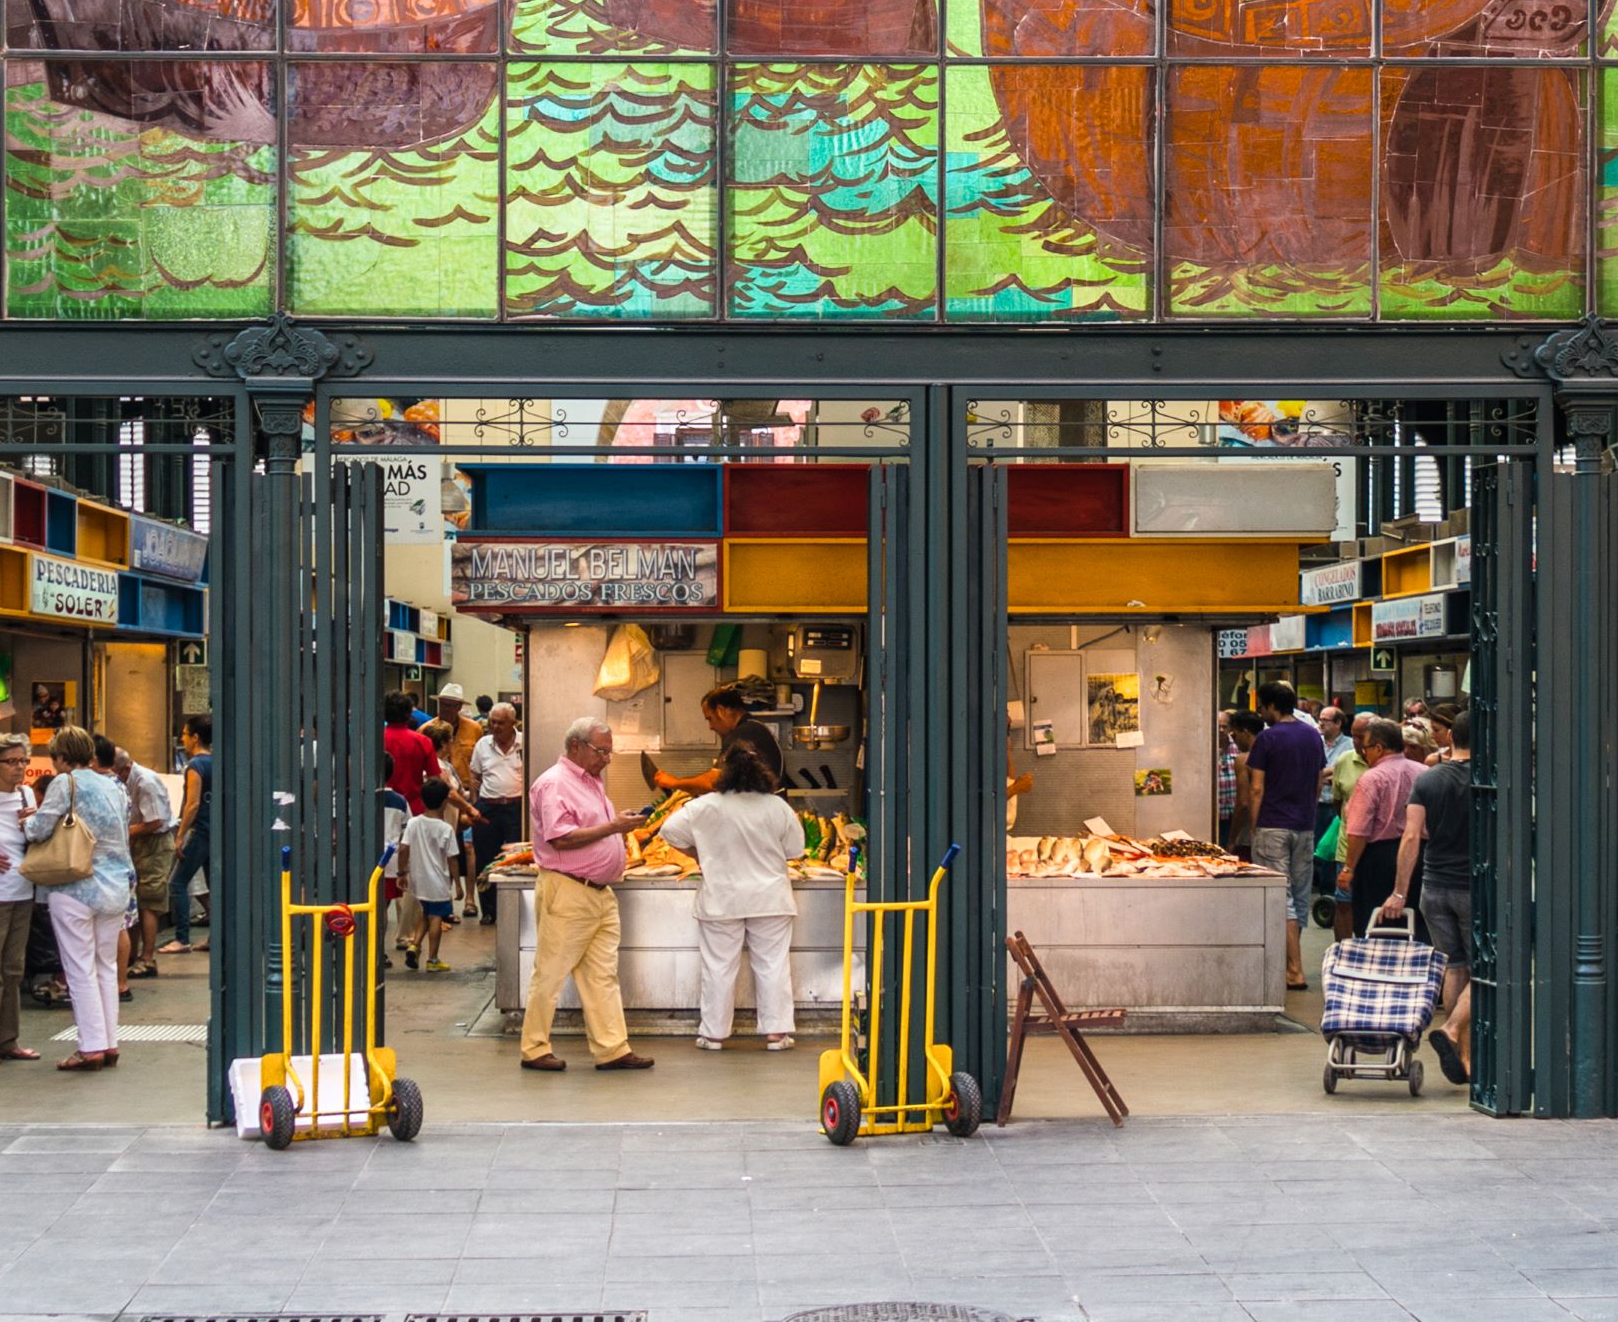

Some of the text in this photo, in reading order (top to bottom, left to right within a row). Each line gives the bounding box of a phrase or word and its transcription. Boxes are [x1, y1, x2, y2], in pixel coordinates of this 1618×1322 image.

[387, 460, 427, 480] MÁS
[36, 558, 118, 596] PESCADERIA
[472, 547, 697, 581] MANUEL BELMAN
[469, 582, 704, 602] PESCADOS FRESCOS
